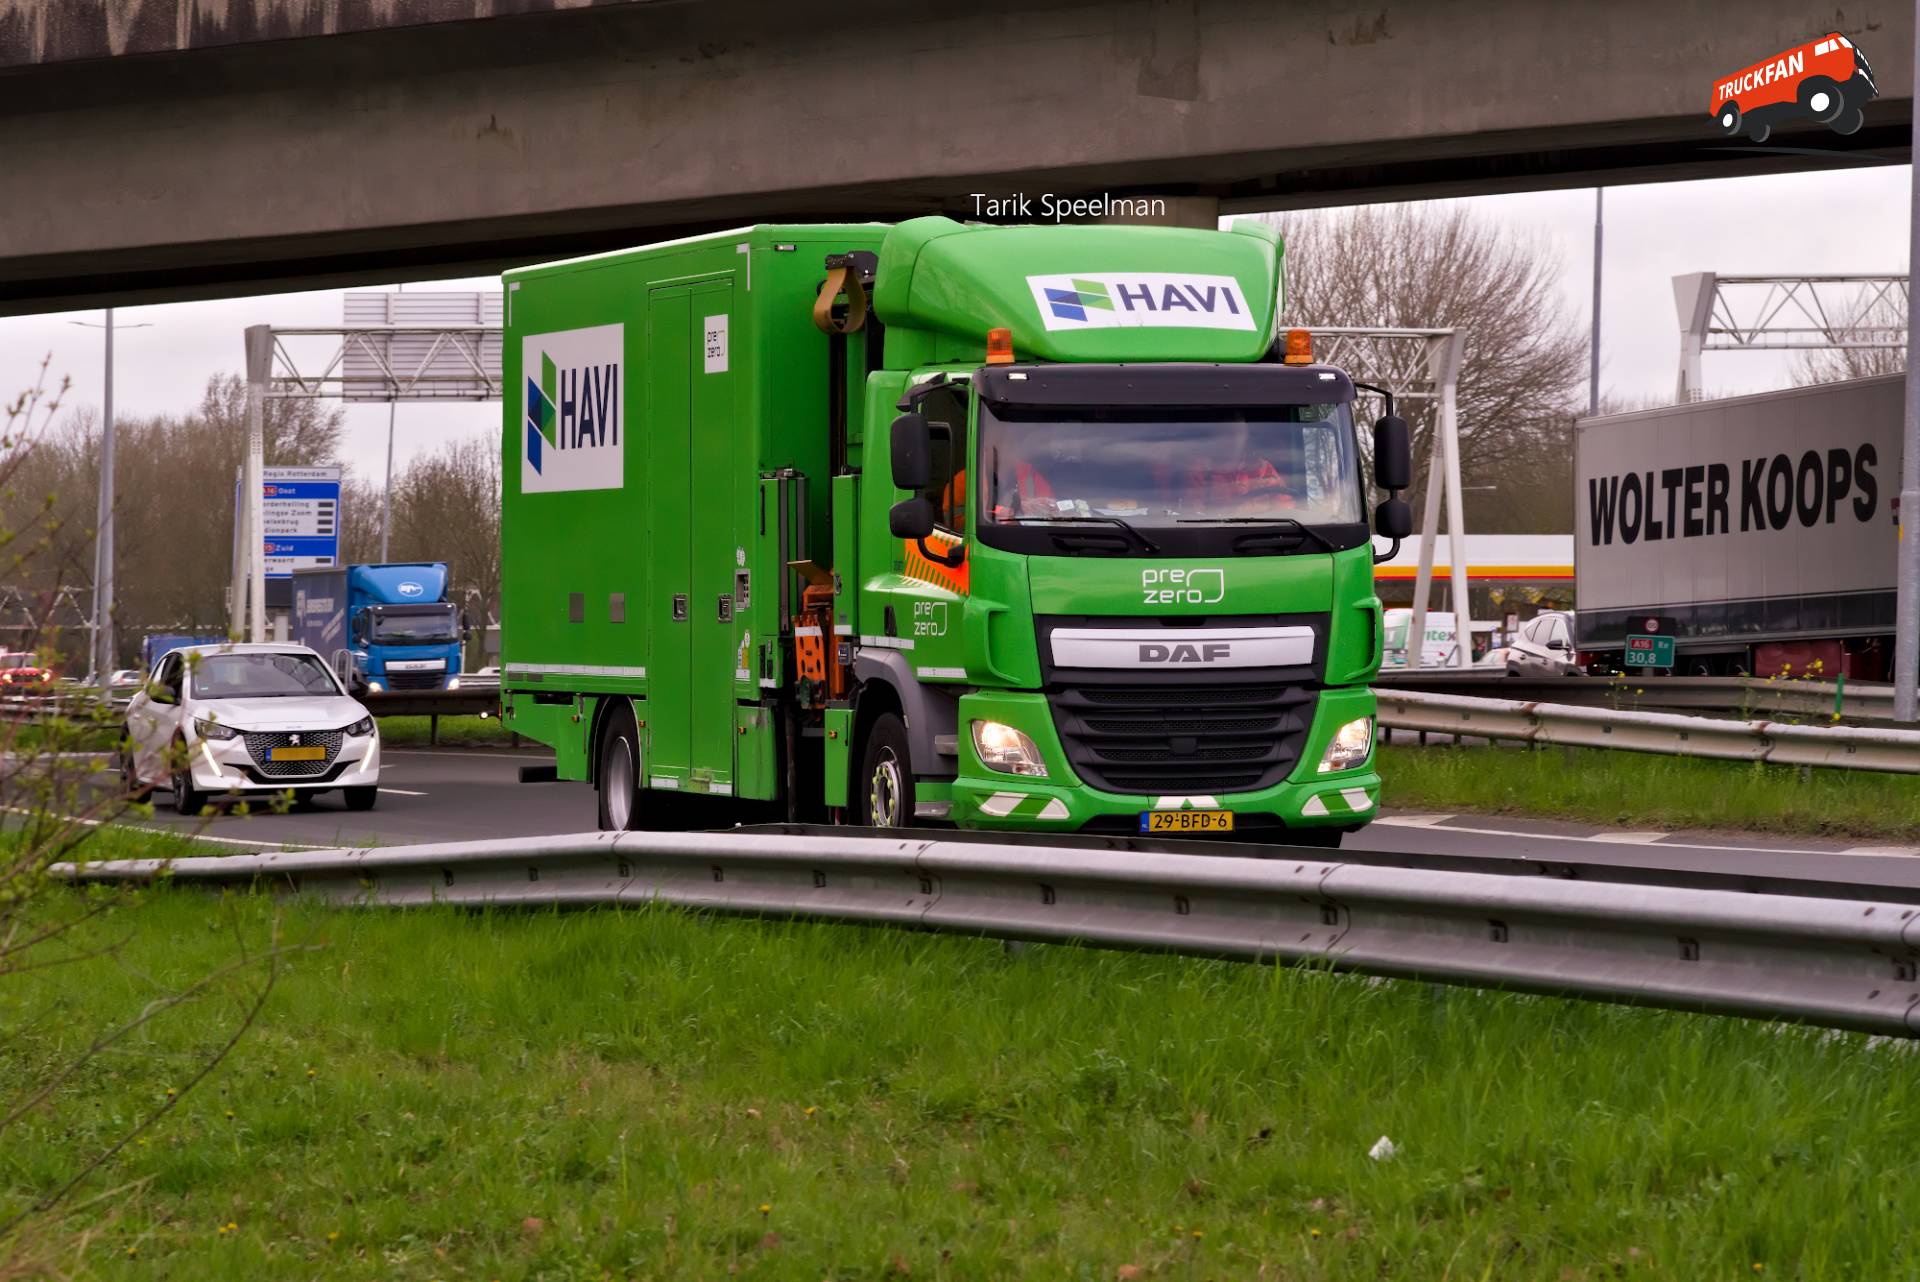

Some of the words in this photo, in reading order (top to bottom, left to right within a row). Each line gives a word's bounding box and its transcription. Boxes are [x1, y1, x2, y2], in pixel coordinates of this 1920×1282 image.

[1116, 283, 1240, 315] HAVI
[561, 363, 618, 450] HAVI
[1589, 463, 1730, 546] WOLTER
[1740, 443, 1878, 532] KOOPS
[1142, 569, 1185, 587] pre
[1143, 590, 1202, 604] zero
[914, 602, 931, 618] pre
[914, 622, 938, 636] zero
[1424, 630, 1457, 641] itex
[1139, 644, 1230, 663] DAF
[1628, 652, 1657, 664] 30,8
[1154, 813, 1227, 829] 29-BFD-6
